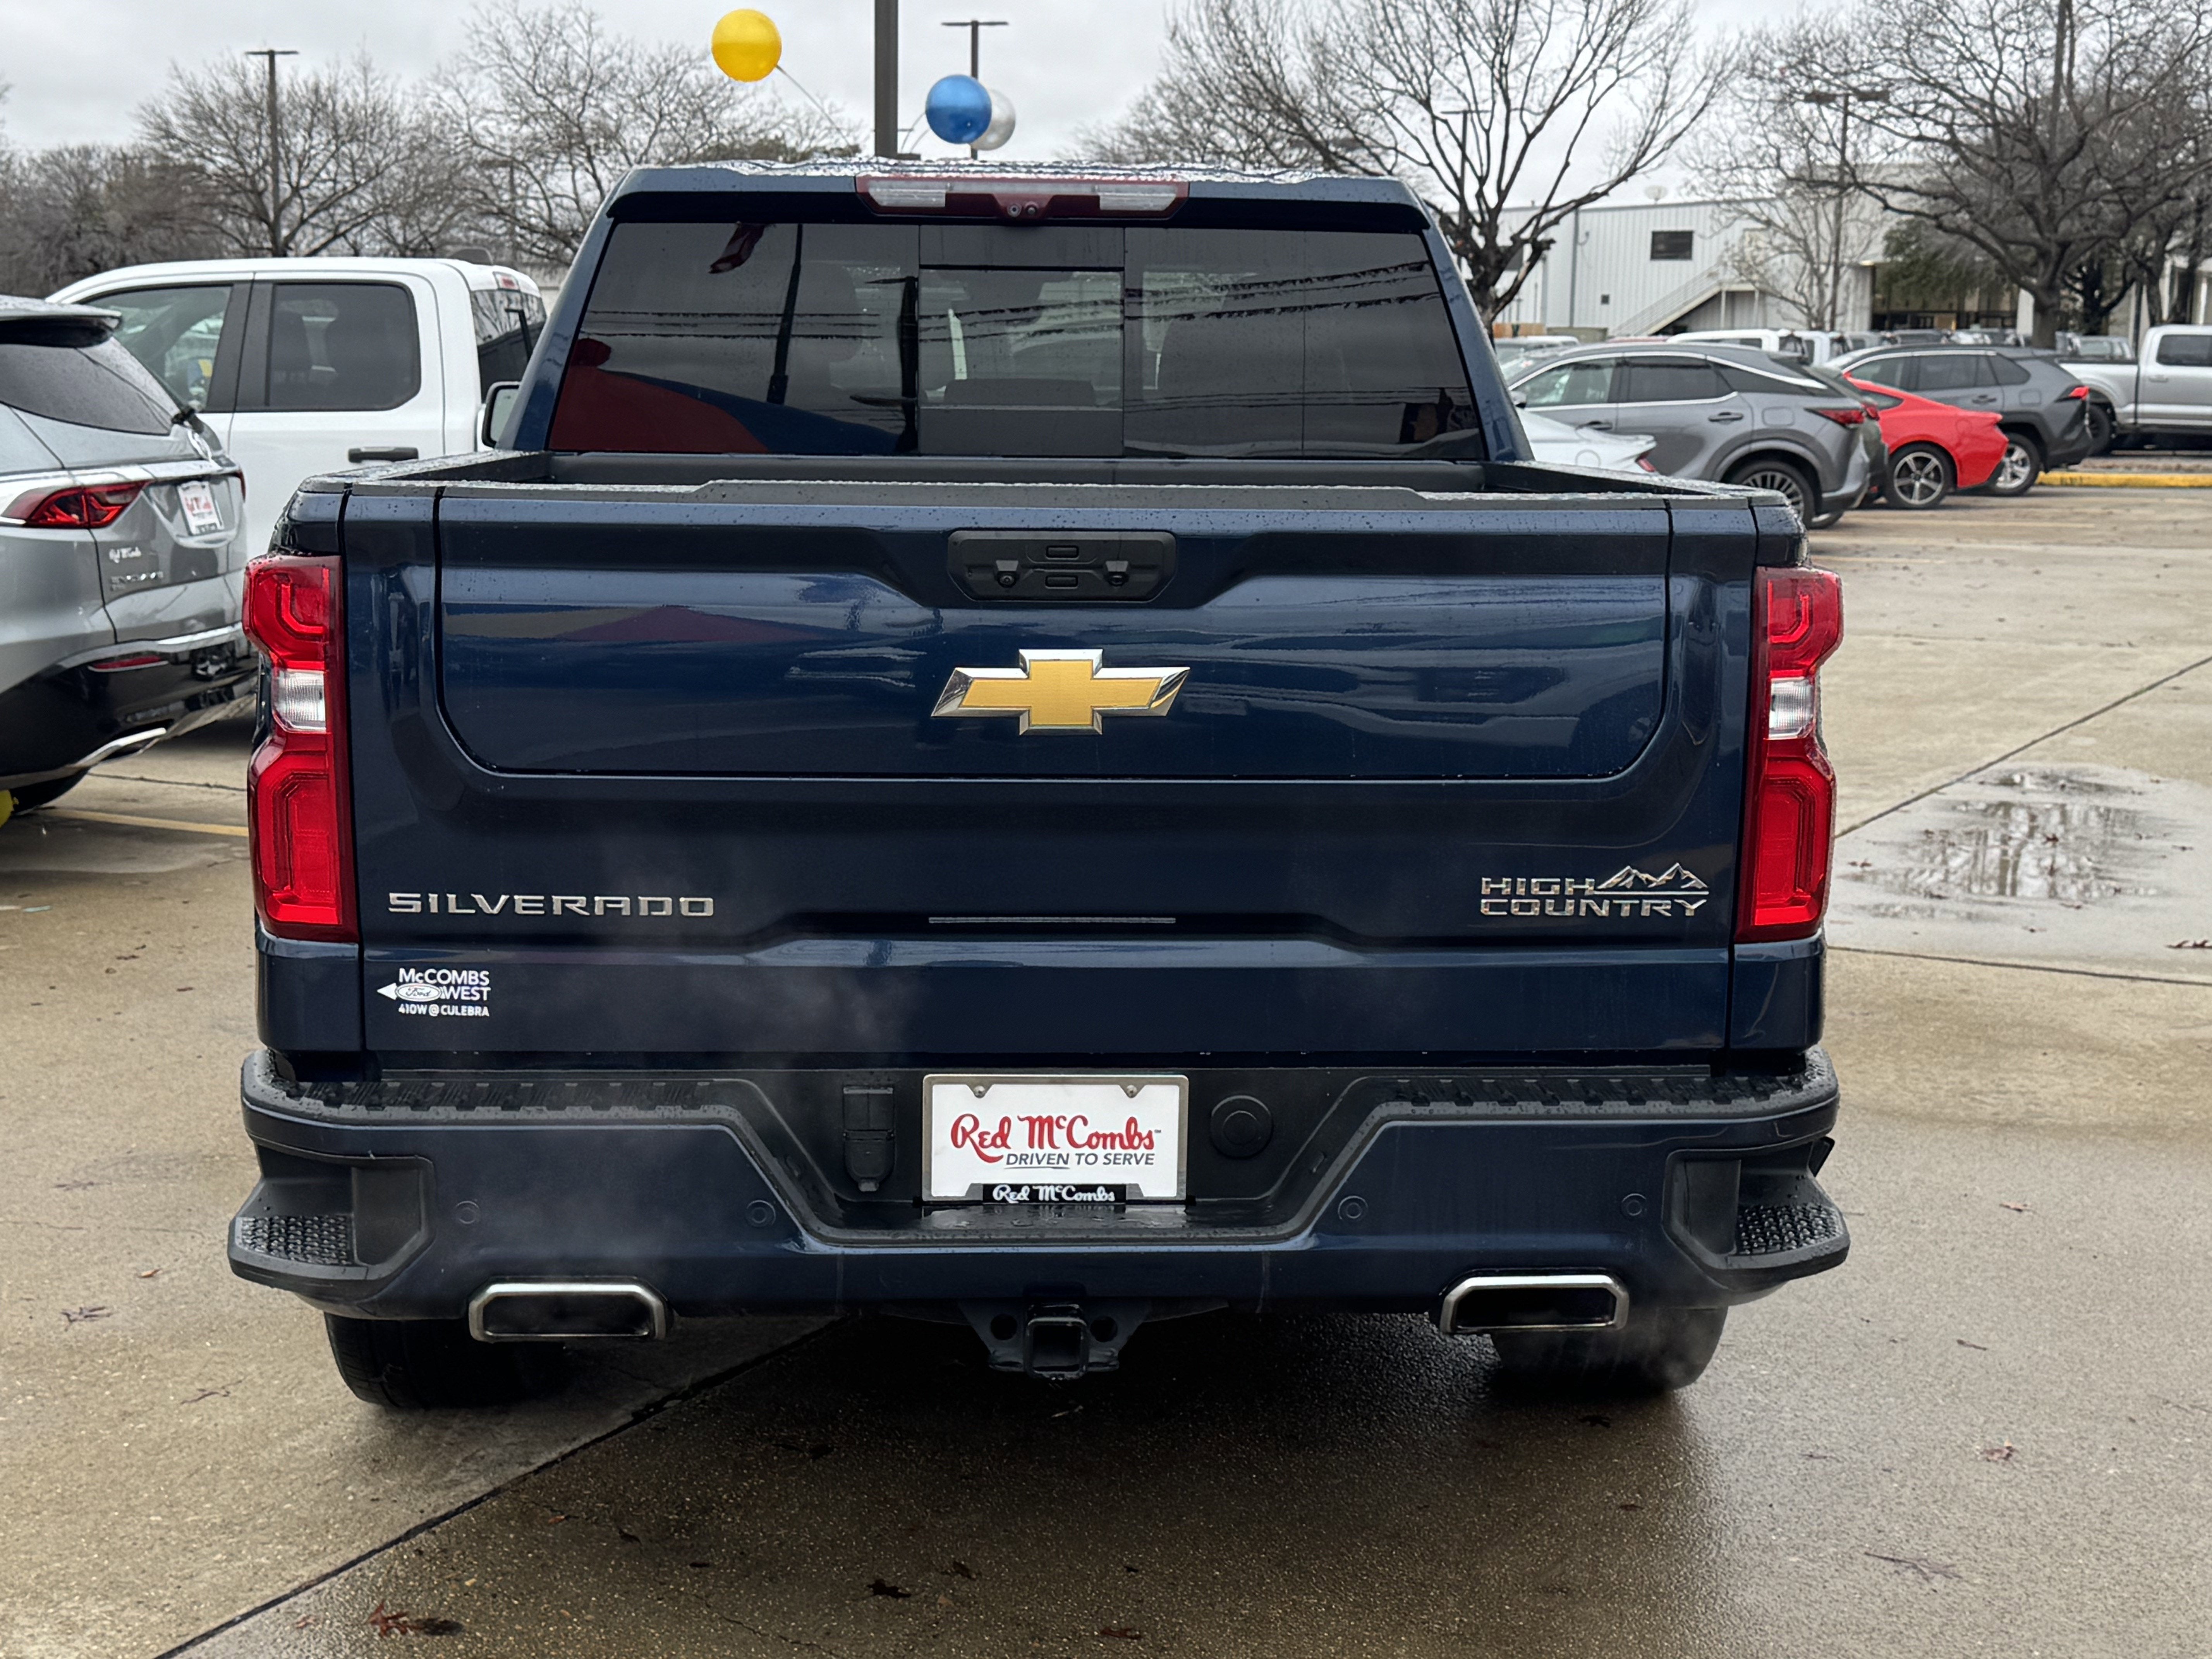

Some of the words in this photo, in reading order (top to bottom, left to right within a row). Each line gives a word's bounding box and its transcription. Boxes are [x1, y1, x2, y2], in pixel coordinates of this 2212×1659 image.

[1481, 878, 1595, 896] HIGH
[388, 893, 714, 916] SILVERADO
[1480, 899, 1707, 916] COUNTRY
[398, 968, 490, 986] McCOMBS
[444, 986, 491, 1001] WEST
[398, 1004, 427, 1015] 410W
[441, 1005, 489, 1017] CULEBRA
[951, 1113, 1012, 1163] Red
[1017, 1115, 1154, 1150] McCombs
[1006, 1153, 1070, 1165] DRIVEN
[1076, 1153, 1097, 1165] TO
[1103, 1153, 1155, 1166] SERVE
[993, 1185, 1030, 1203] Red
[1033, 1186, 1116, 1202] McCombs
